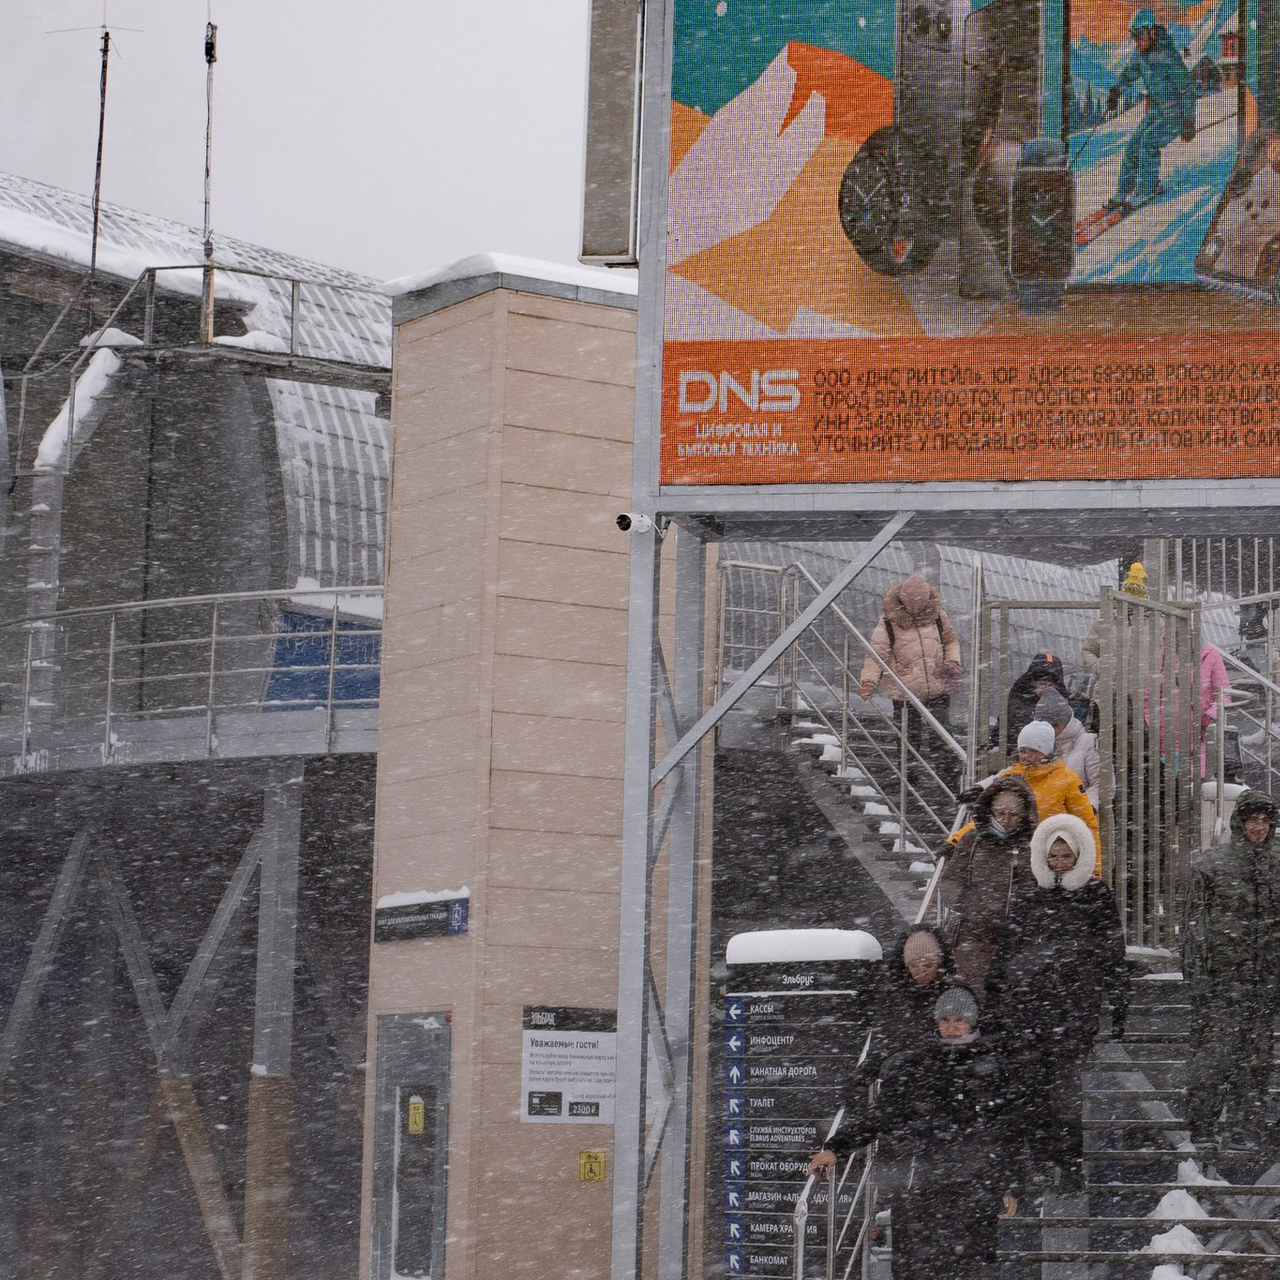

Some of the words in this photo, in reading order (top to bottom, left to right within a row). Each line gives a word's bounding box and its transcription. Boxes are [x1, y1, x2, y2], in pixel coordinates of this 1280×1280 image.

[814, 369, 850, 387] ООО
[679, 370, 800, 413] DNS
[814, 391, 870, 410] ГОРОД
[1011, 387, 1100, 406] ПРОСПЕКТ
[814, 413, 849, 430] ИНН
[1147, 406, 1263, 427] КОЛИЧЕСТВО
[812, 431, 912, 454] УТОЧНЯЙТЕ
[919, 433, 929, 452] У
[782, 974, 814, 986] Эльбрус
[750, 1005, 774, 1013] КАССЫ
[530, 1038, 575, 1049] Уважаемые
[576, 1040, 599, 1049] гости!
[750, 1036, 794, 1047] ИНФОЦЕНТР
[750, 1067, 787, 1076] КАНАТНАЯ
[788, 1067, 817, 1078] ДОРОГА
[750, 1098, 775, 1107] ТУАЛЕТ
[572, 1105, 590, 1114] 2300
[750, 1126, 772, 1134] СЛУЖБА
[773, 1126, 816, 1135] ИНСТРУКТОРОВ
[750, 1134, 769, 1142] ELBRUS
[751, 1162, 778, 1171] ПРОКАТ
[749, 1192, 782, 1201] МАГАЗИН
[750, 1223, 779, 1232] КАМЕРА
[780, 1224, 817, 1234] ХРАИЯ
[750, 1255, 788, 1265] БАНКОМАТ
